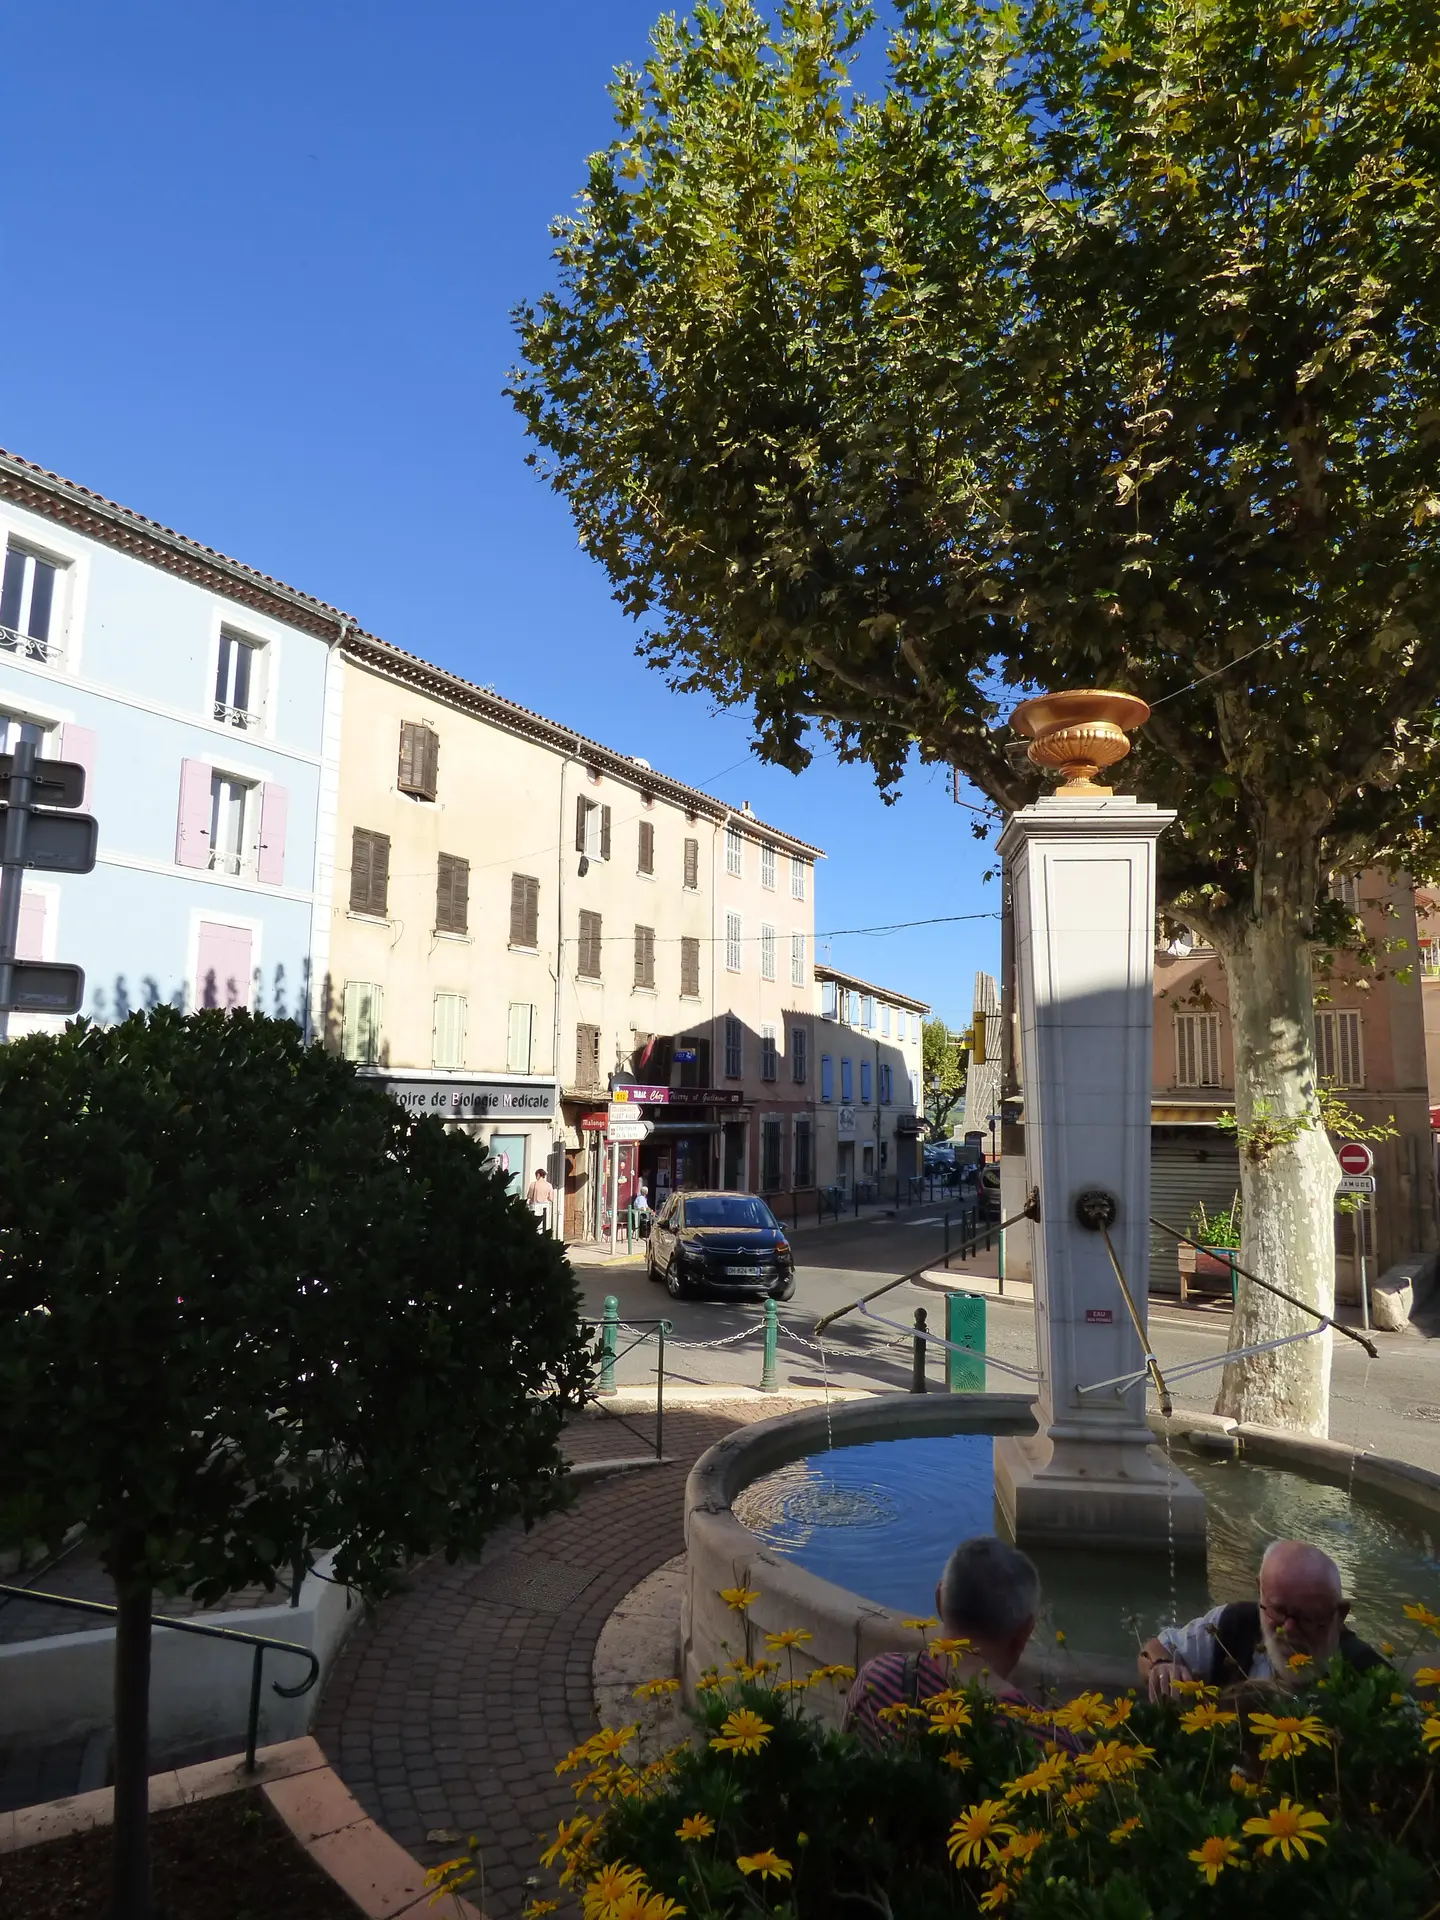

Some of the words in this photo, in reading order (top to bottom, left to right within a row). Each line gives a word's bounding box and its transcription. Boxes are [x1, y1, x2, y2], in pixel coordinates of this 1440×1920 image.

[431, 1092, 447, 1107] de
[451, 1092, 499, 1110] Biologie
[502, 1093, 549, 1108] Medicale
[649, 1090, 664, 1103] Chez
